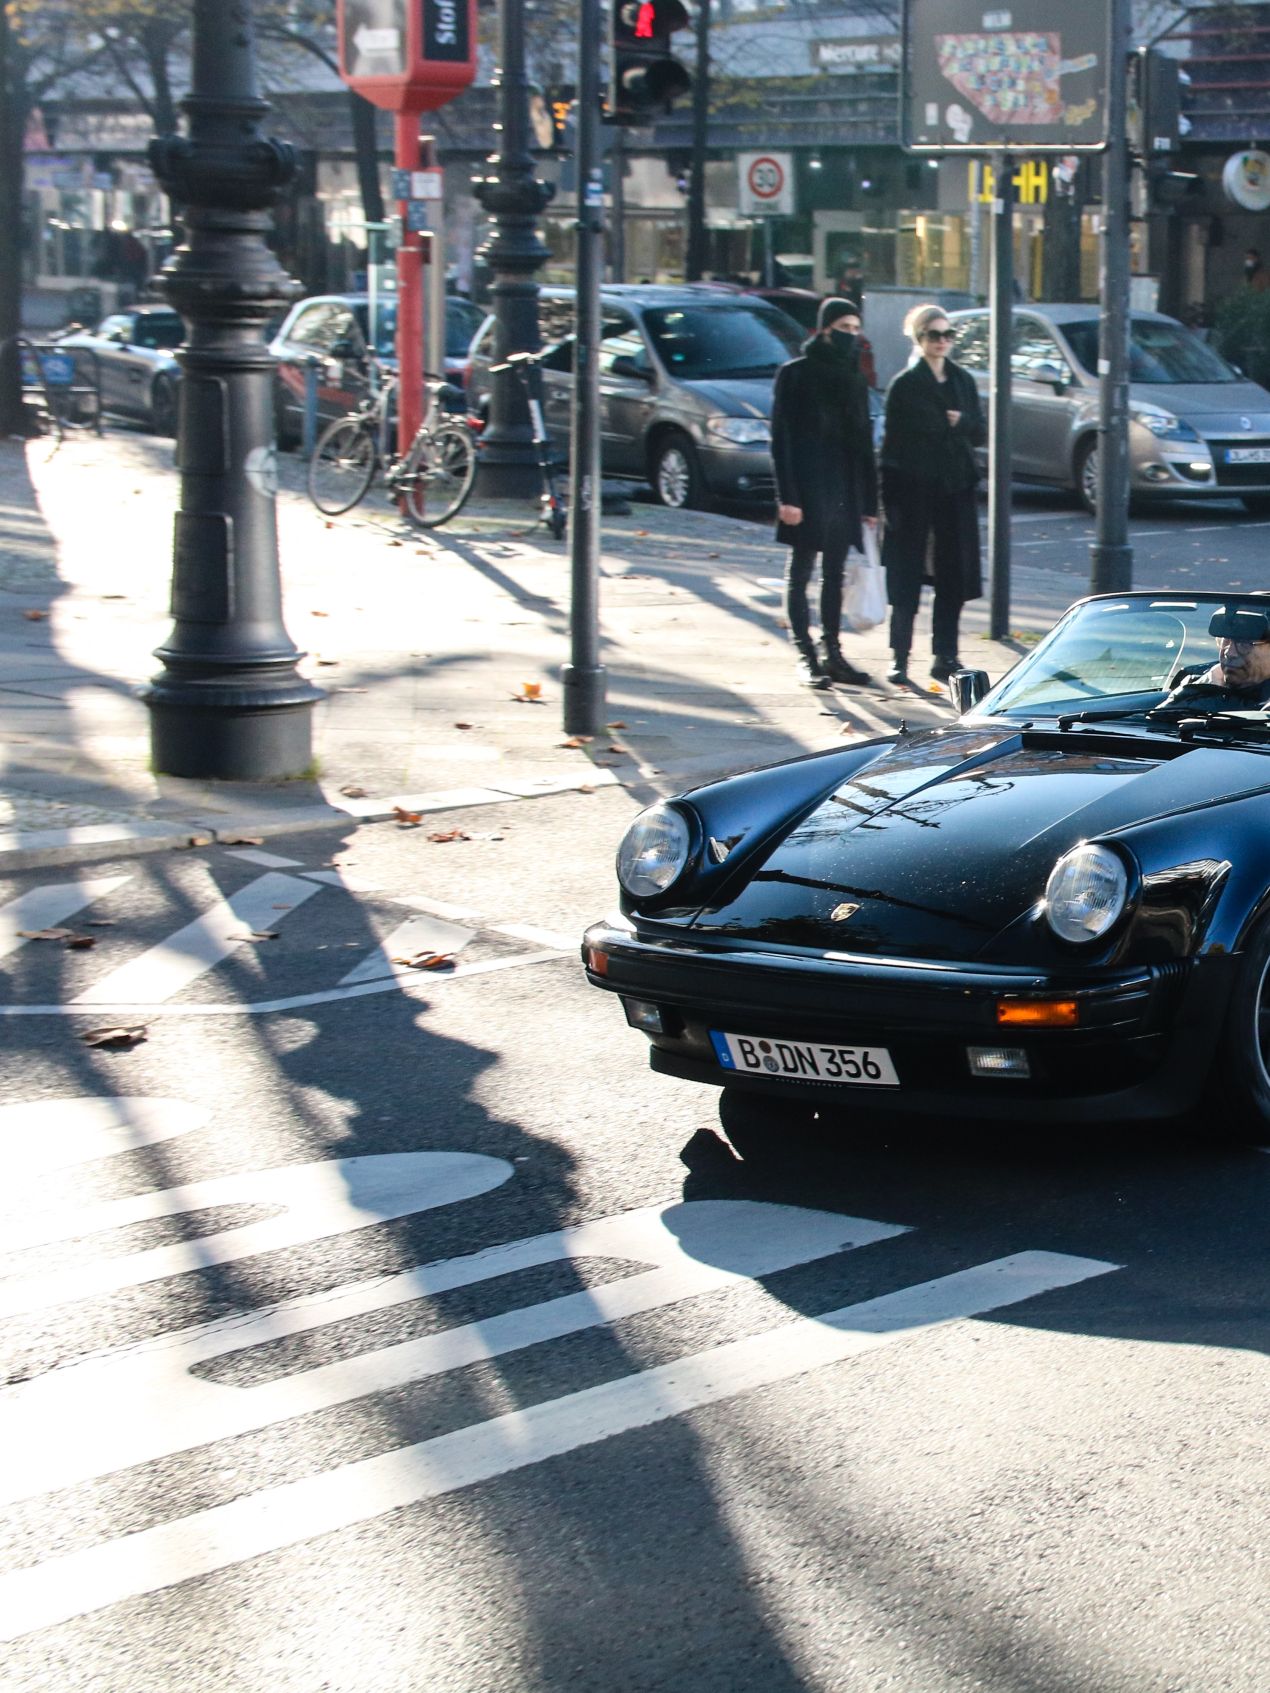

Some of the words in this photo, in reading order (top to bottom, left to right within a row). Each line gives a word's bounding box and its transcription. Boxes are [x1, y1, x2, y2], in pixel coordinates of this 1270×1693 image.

[755, 167, 778, 188] 30
[737, 1038, 762, 1069] B
[775, 1043, 820, 1076] DN
[820, 1047, 882, 1080] 356
